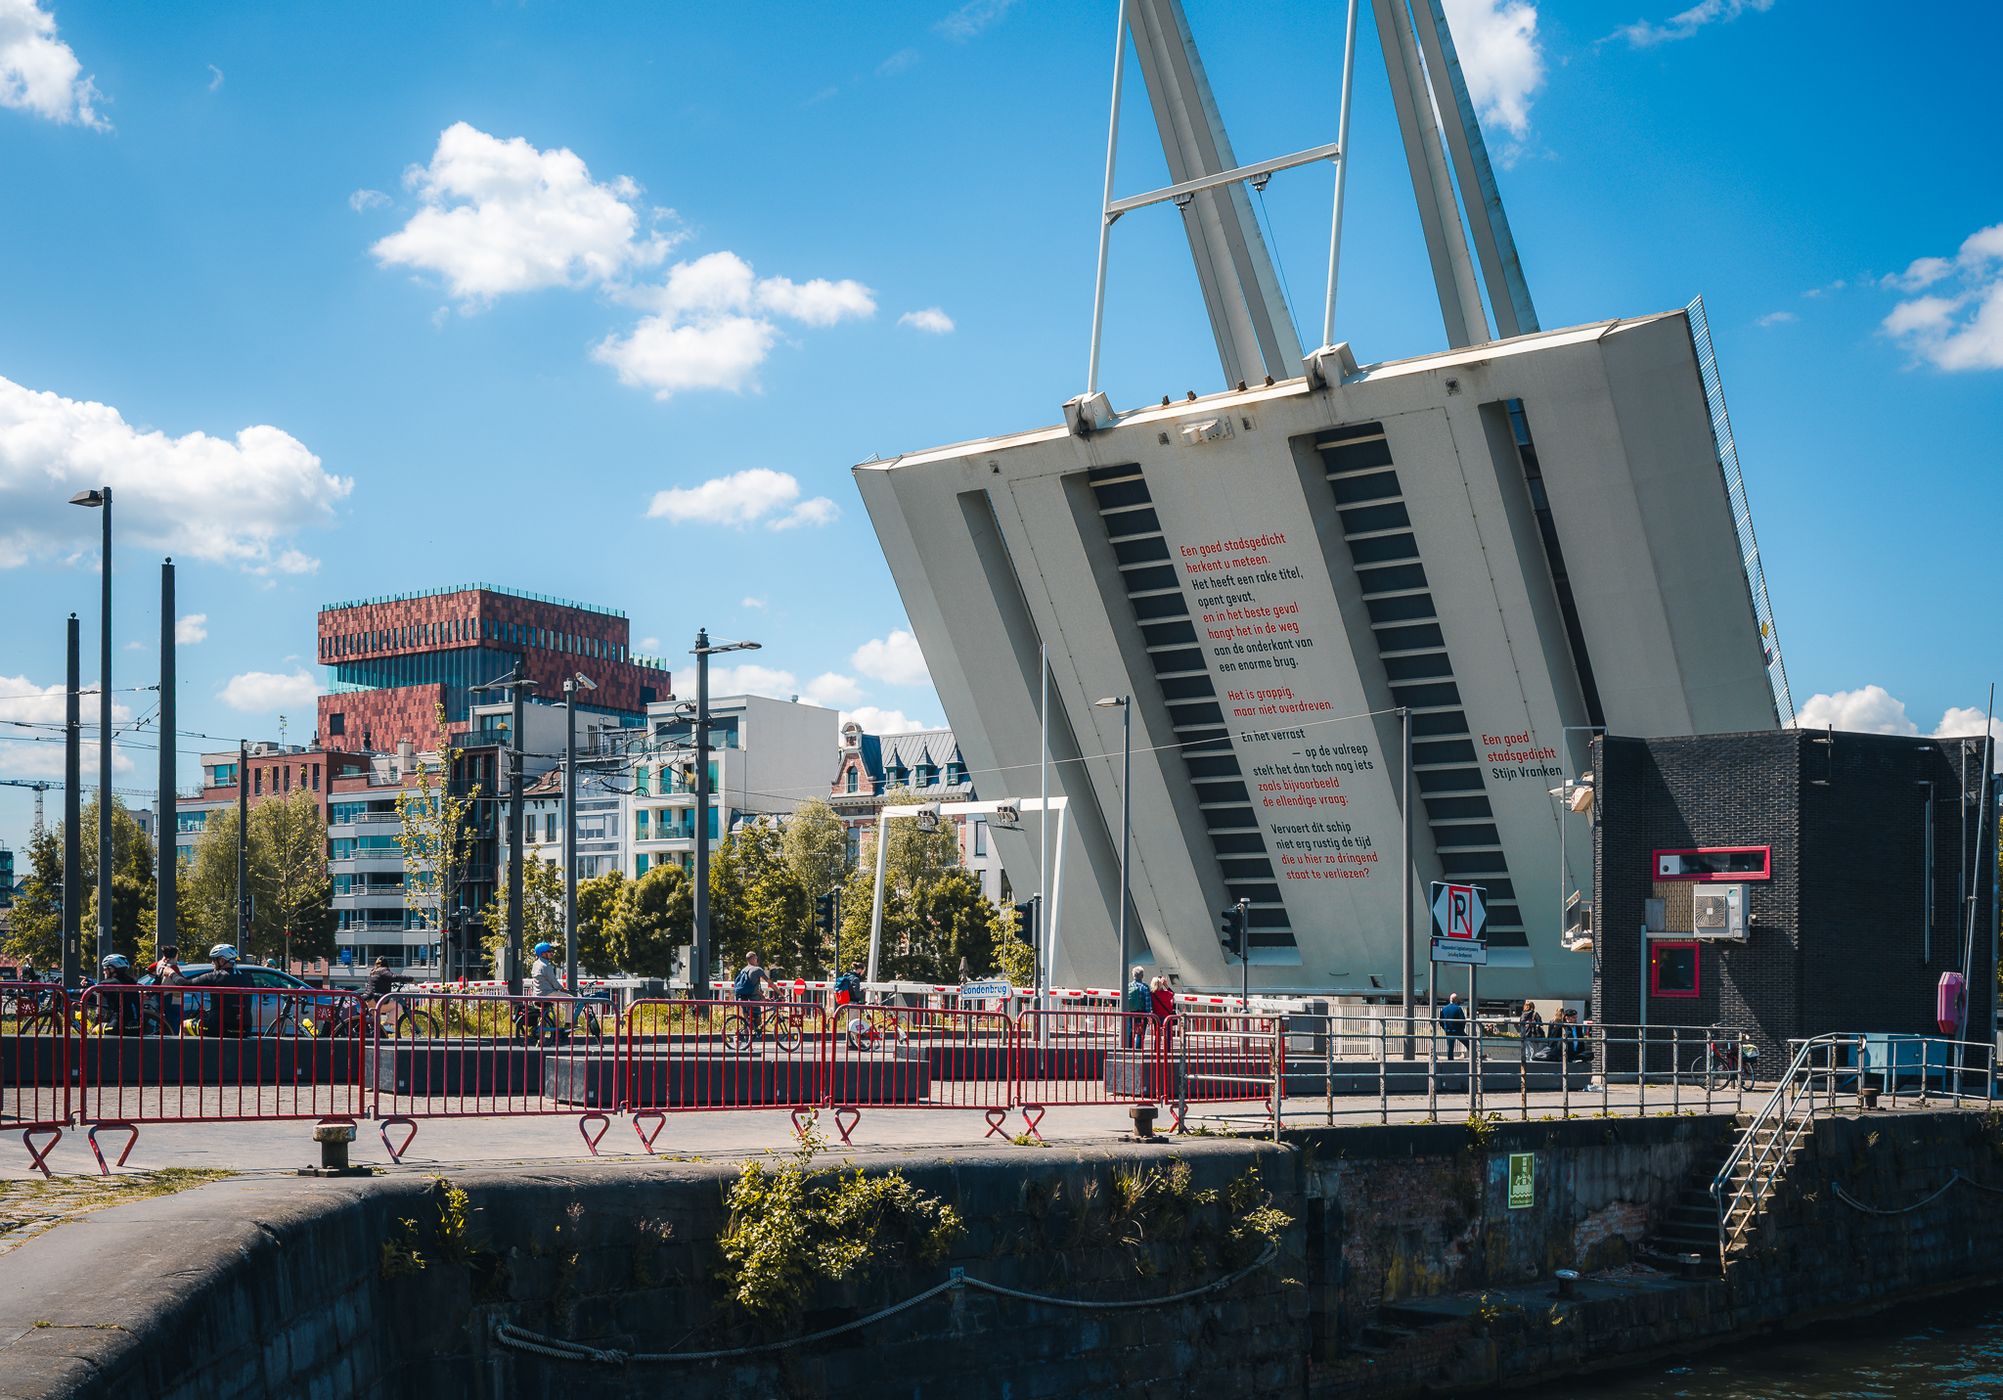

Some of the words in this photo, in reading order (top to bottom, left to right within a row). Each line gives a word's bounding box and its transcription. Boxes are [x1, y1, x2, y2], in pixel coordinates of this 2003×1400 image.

[1180, 546, 1198, 556] Een
[1200, 540, 1222, 557] goed
[1224, 532, 1286, 551] stadsgedicht
[1186, 560, 1222, 573] herkent
[1232, 556, 1270, 567] meteen.
[1192, 579, 1209, 590] Het
[1209, 575, 1236, 588] heeft
[1237, 576, 1254, 585] een
[1256, 570, 1277, 582] rake
[1279, 566, 1303, 580] titel,
[1198, 594, 1224, 609] opent
[1226, 591, 1256, 607] gevat,
[1203, 614, 1215, 622] en
[1217, 613, 1226, 621] in
[1226, 609, 1243, 620] het
[1244, 607, 1270, 618] beste
[1273, 601, 1298, 618] geval
[1208, 628, 1235, 640] hangt
[1235, 626, 1252, 636] het
[1253, 624, 1263, 634] in
[1265, 622, 1276, 633] de
[1278, 623, 1299, 634] weg
[1214, 647, 1231, 656] aan
[1233, 643, 1244, 654] de
[1246, 639, 1294, 653] onderkant
[1295, 639, 1313, 648] van
[1219, 663, 1236, 672] een
[1238, 660, 1272, 670] enorme
[1273, 656, 1298, 669] brug.
[1228, 690, 1245, 700] Het
[1245, 690, 1254, 699] is
[1257, 686, 1294, 701] grappig,
[1234, 708, 1256, 716] maar
[1258, 704, 1277, 714] niet
[1279, 700, 1334, 713] overdreven.
[1241, 731, 1253, 742] En
[1254, 731, 1270, 741] het
[1271, 729, 1306, 740] verrast
[1482, 734, 1501, 745] Een
[1504, 730, 1529, 747] goed
[1306, 748, 1317, 760] op
[1319, 745, 1330, 756] de
[1332, 744, 1368, 756] valreep
[1488, 747, 1556, 763] stadsgedicht
[1253, 764, 1274, 776] stelt
[1275, 764, 1292, 774] het
[1293, 763, 1310, 774] dan
[1312, 761, 1333, 772] toch
[1335, 763, 1354, 773] nog
[1354, 760, 1373, 770] iets
[1492, 768, 1517, 781] Stijn
[1518, 764, 1562, 777] Vranken
[1258, 780, 1282, 791] zoals
[1282, 777, 1339, 792] bijvoorbeeld
[1263, 796, 1274, 806] de
[1276, 794, 1316, 808] ellendige
[1319, 796, 1348, 806] vraag:
[1270, 824, 1310, 834] Vervoert
[1312, 822, 1324, 832] dit
[1326, 821, 1351, 834] schip
[1276, 839, 1294, 849] niet
[1296, 841, 1311, 851] erg
[1313, 838, 1340, 850] rustig
[1342, 836, 1353, 847] de
[1355, 836, 1371, 849] tijd
[1282, 854, 1295, 864] die
[1304, 853, 1322, 863] hier
[1337, 851, 1378, 865] dringend
[1286, 870, 1310, 879] staat
[1312, 870, 1321, 879] te
[1323, 868, 1369, 878] verliezen?
[964, 984, 1007, 995] Londenbrug
